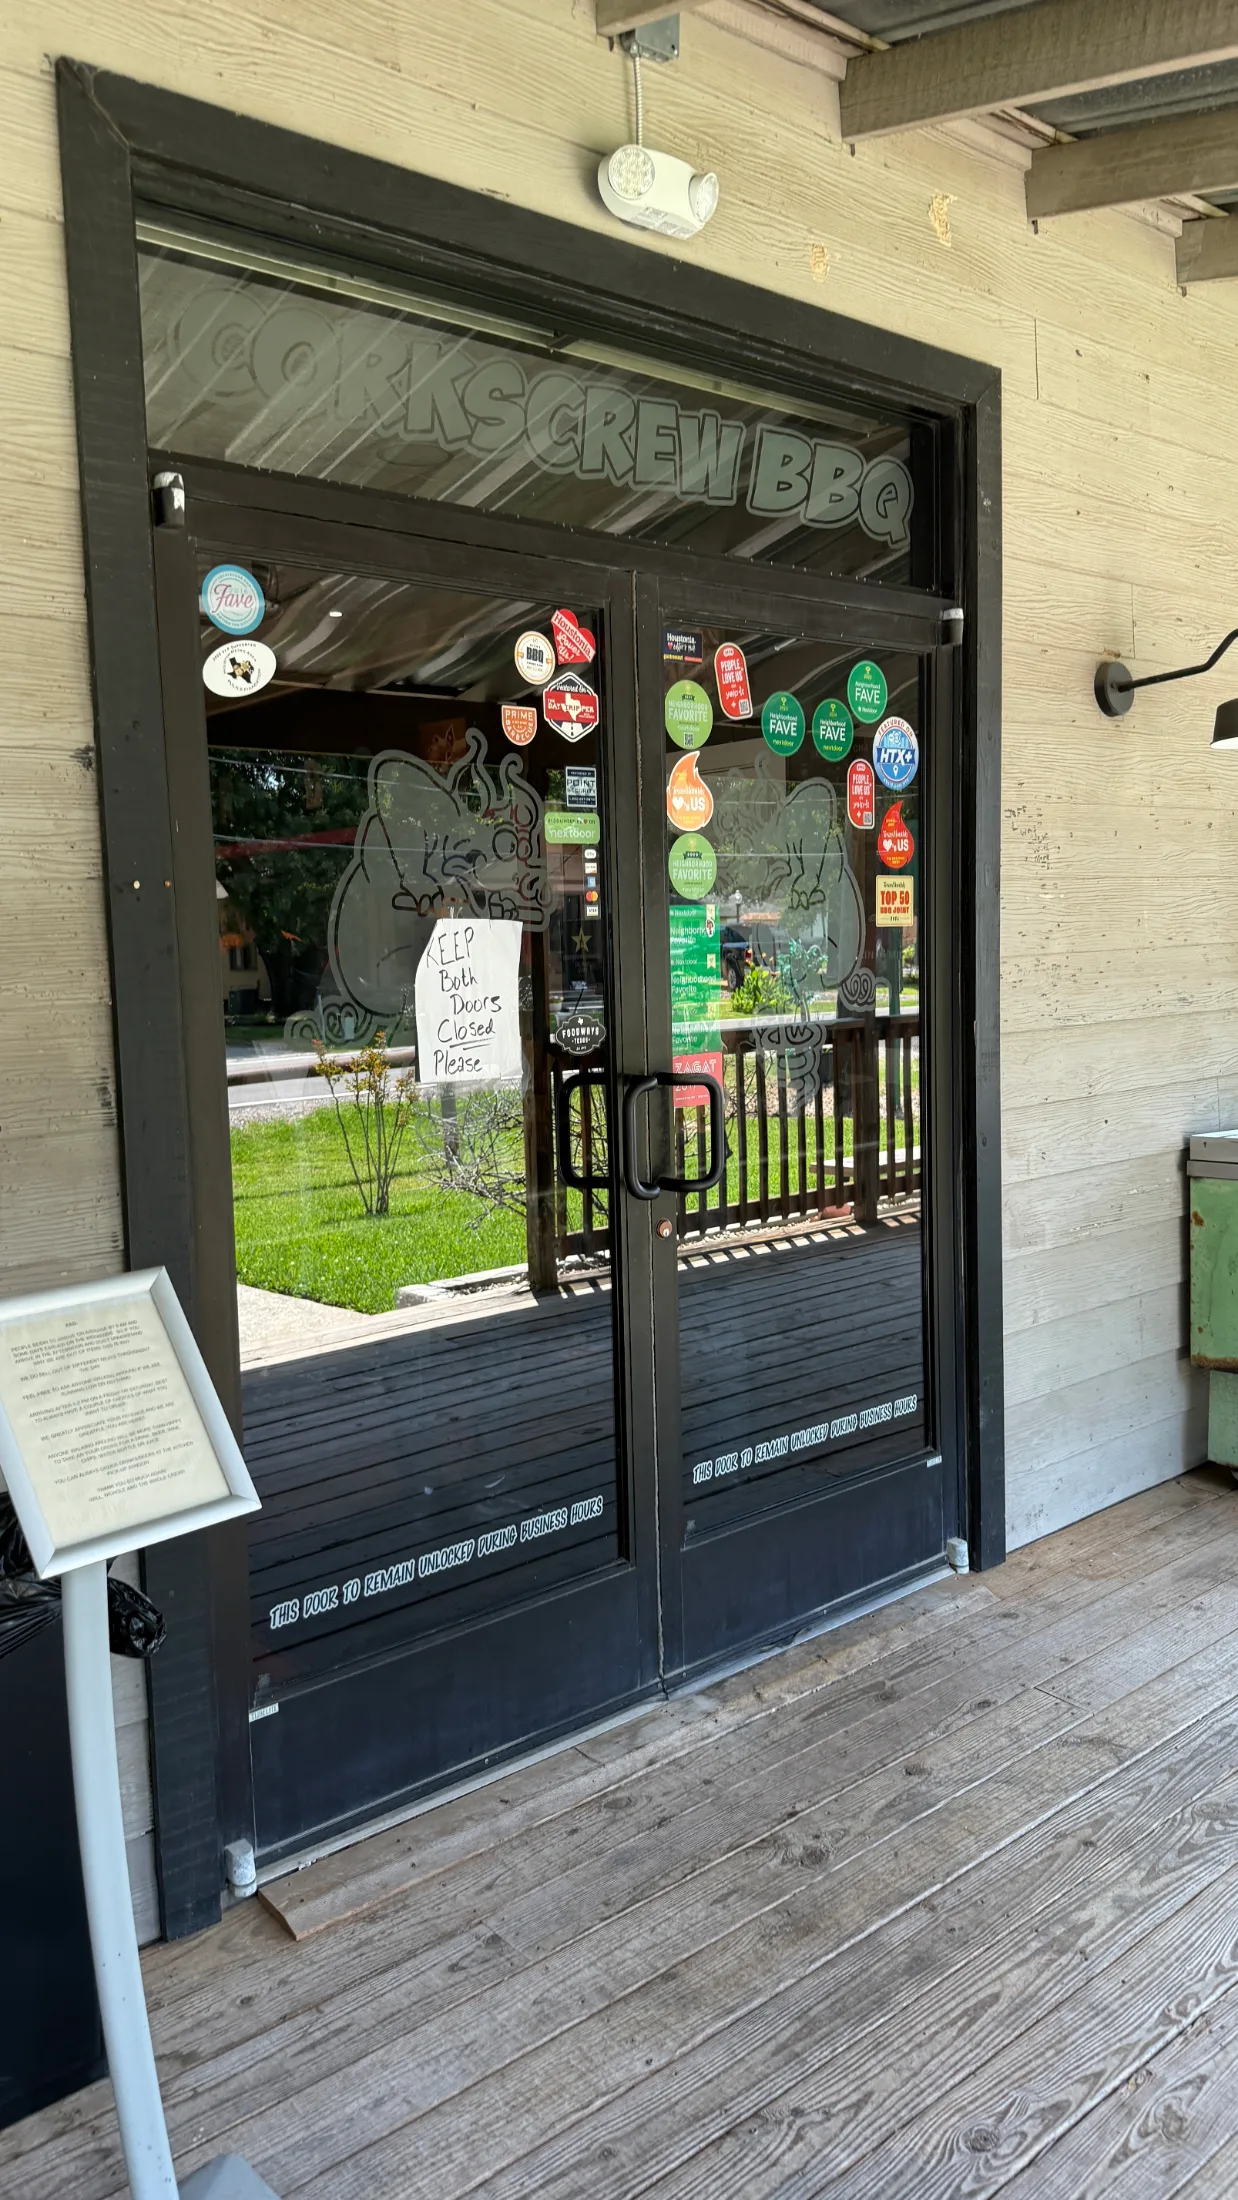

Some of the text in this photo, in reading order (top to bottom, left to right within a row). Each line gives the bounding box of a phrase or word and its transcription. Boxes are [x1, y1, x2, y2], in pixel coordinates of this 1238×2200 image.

[170, 288, 912, 547] CORKSCREW BBQ
[212, 583, 254, 613] Fave
[720, 658, 740, 673] PEOPLE
[721, 670, 743, 685] LOVE US
[855, 687, 880, 704] FAVE
[505, 709, 533, 722] PRIME
[668, 707, 708, 723] FAVORITE
[505, 719, 533, 741] BARBECUE
[770, 719, 797, 736] FAVE
[820, 726, 846, 742] FAVE
[567, 779, 595, 787] POINT
[852, 773, 869, 784] PEOPLE
[852, 785, 870, 795] LOVE US
[690, 797, 705, 812] US
[548, 826, 596, 838] nextdoor
[897, 839, 909, 852] US
[673, 869, 713, 880] FAVORITE
[880, 891, 909, 905] TOP 50
[426, 926, 474, 968] KEEP
[439, 967, 478, 992] Both
[450, 993, 502, 1015] Doors
[437, 1018, 496, 1043] Closed
[562, 1026, 599, 1039] FOODWAYS
[434, 1050, 482, 1076] Please
[675, 1059, 717, 1073] ZAGAT
[693, 1394, 917, 1484] THIS DOOR TO REMAIN UNLOCKED DURING BUSINESS HOURS
[269, 1495, 603, 1630] THIS DOOR TO REMAIN UNLOCKED DURING BUSINESS HOURS
